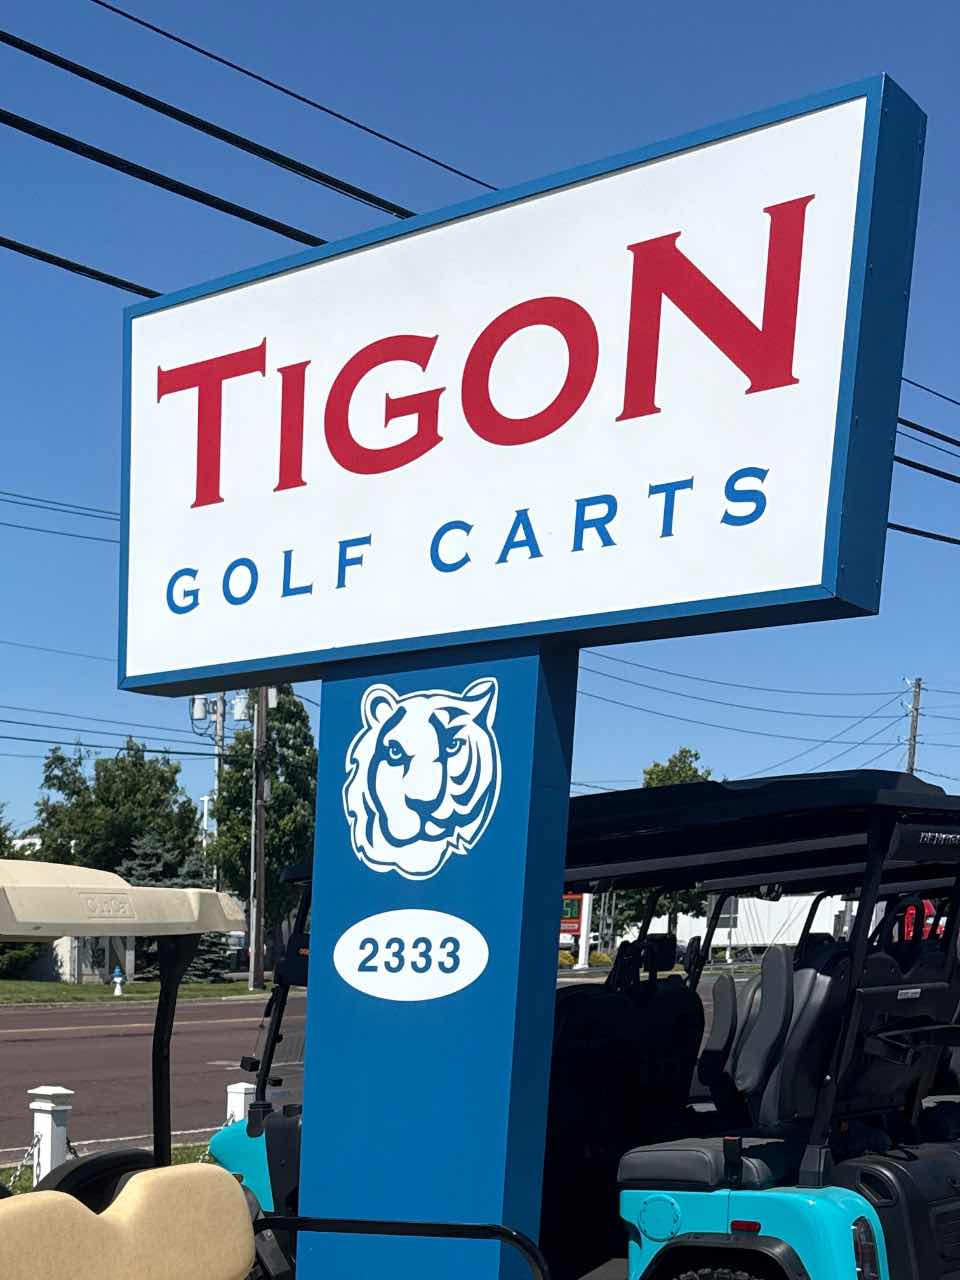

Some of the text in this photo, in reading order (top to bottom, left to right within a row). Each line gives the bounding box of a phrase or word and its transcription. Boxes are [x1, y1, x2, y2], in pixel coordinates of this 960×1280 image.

[157, 194, 815, 508] TIGON
[166, 467, 769, 614] GOLF CARTS
[357, 936, 461, 974] 2333
